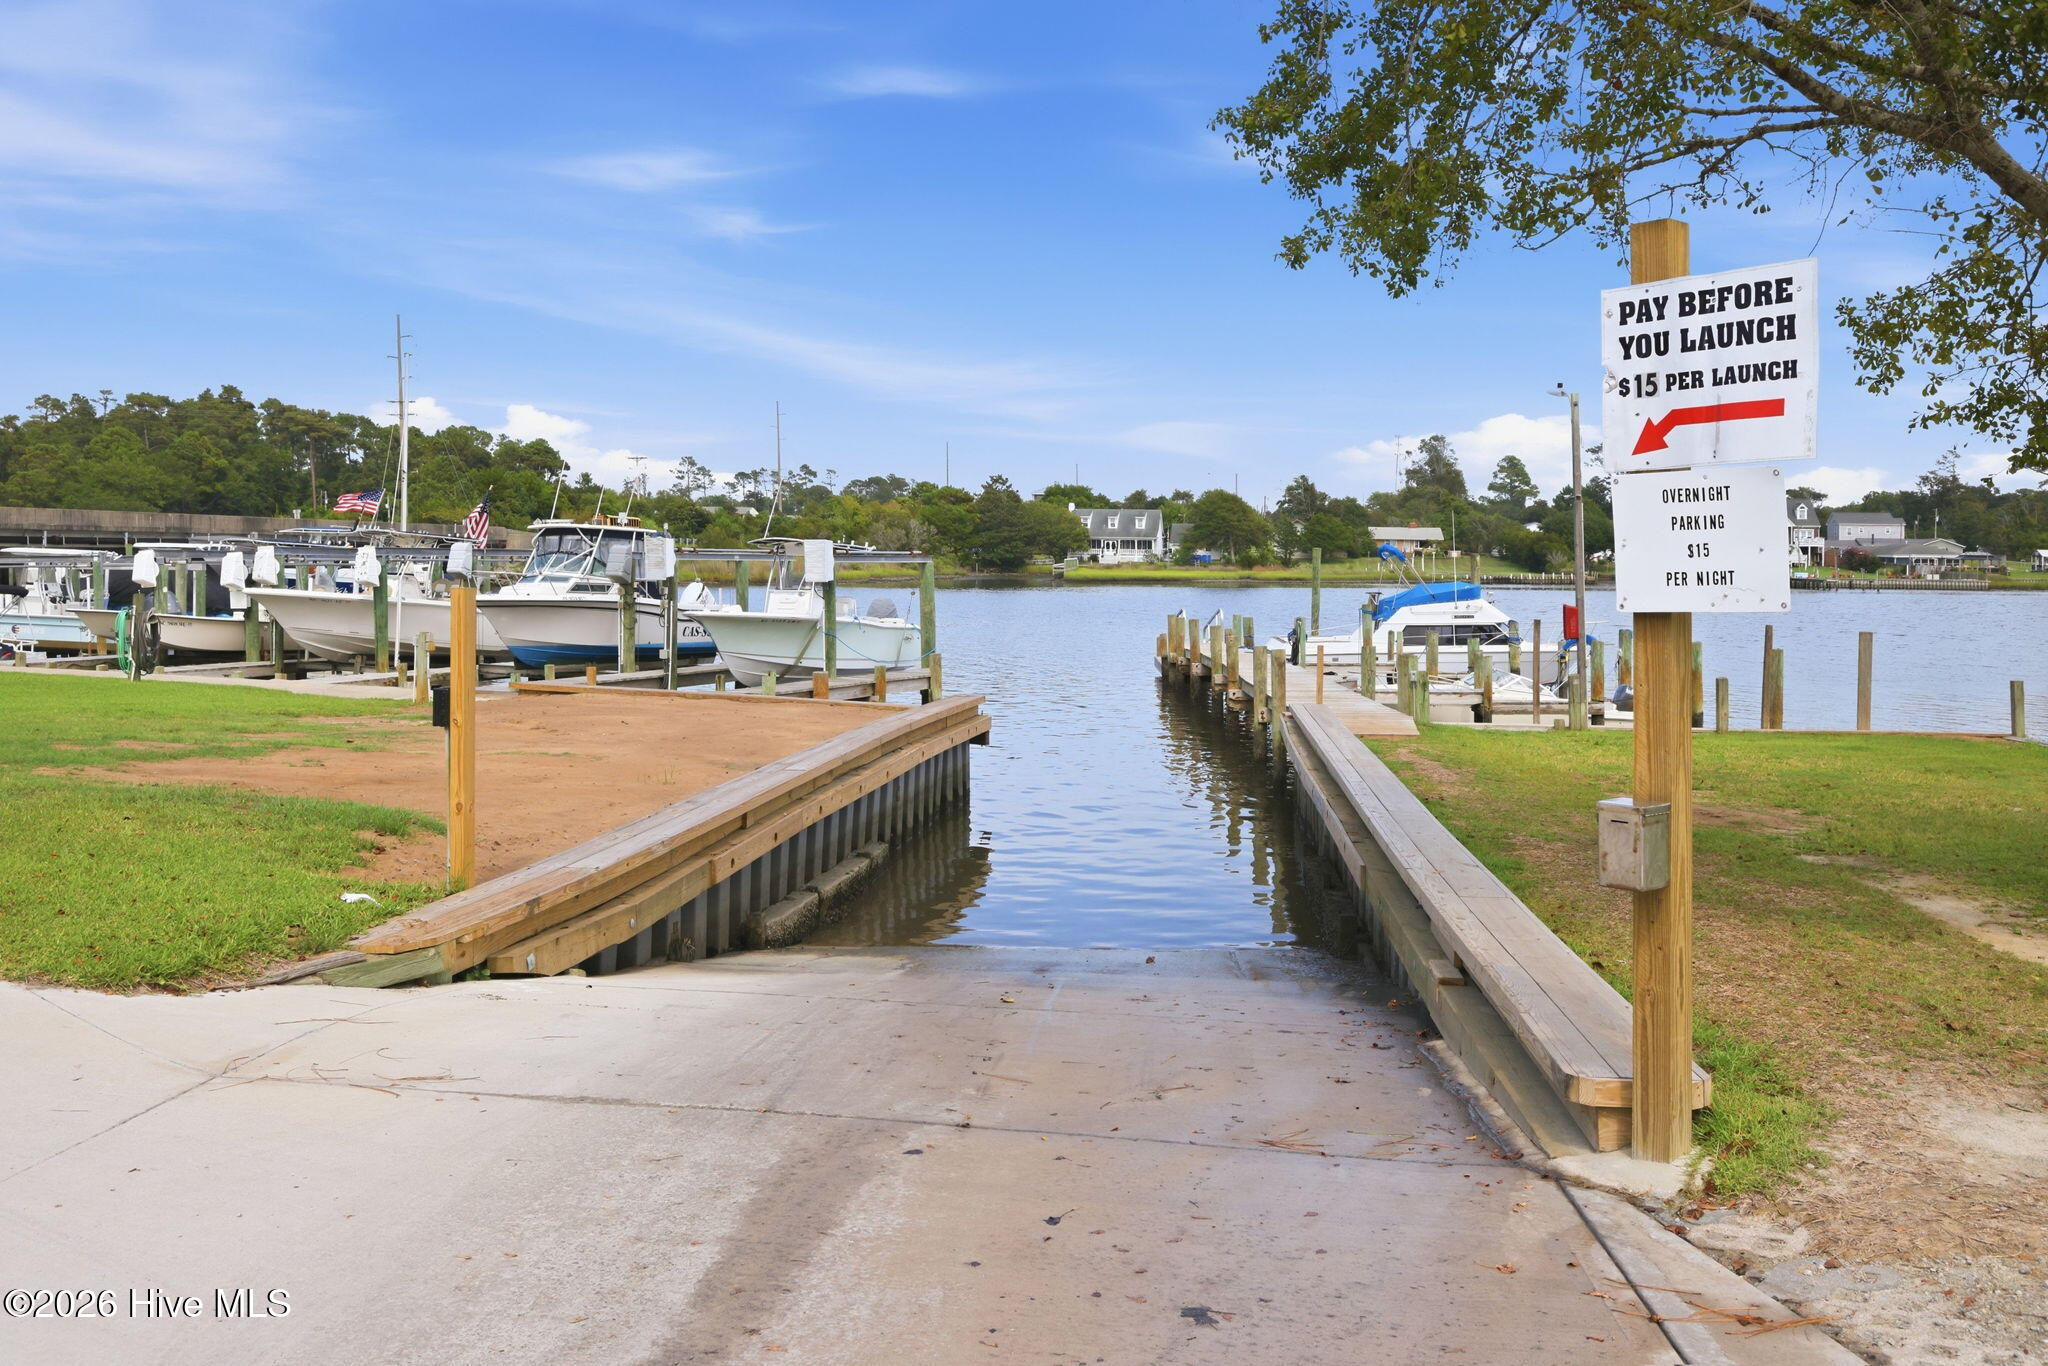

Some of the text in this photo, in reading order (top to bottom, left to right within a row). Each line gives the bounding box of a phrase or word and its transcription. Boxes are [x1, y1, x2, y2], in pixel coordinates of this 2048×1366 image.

[1618, 277, 1793, 326] PAY BEFORE
[1618, 314, 1796, 361] YOU LAUNCH
[1618, 359, 1798, 398] $15 PER LAUNCH
[1662, 486, 1730, 503] OVERNIGHT
[1671, 514, 1725, 531] PARKING
[1687, 543, 1710, 558] $15
[1666, 570, 1735, 587] PER NIGHT
